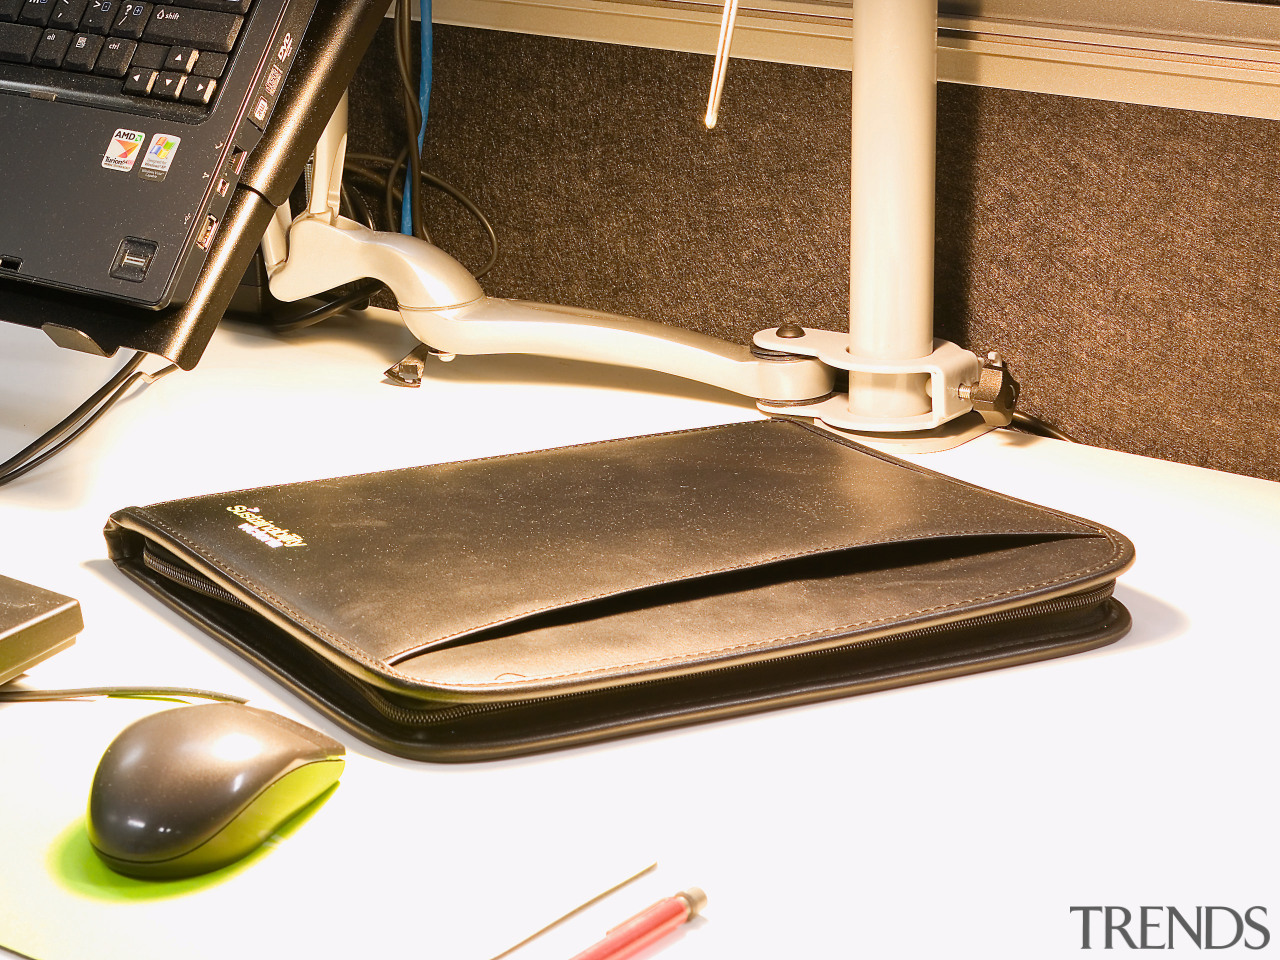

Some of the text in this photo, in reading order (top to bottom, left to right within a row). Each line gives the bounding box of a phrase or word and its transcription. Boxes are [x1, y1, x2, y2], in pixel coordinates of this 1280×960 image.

[164, 12, 180, 20] shift
[108, 42, 120, 50] ctrl
[114, 130, 136, 140] AMD
[226, 505, 308, 548] Sustainability
